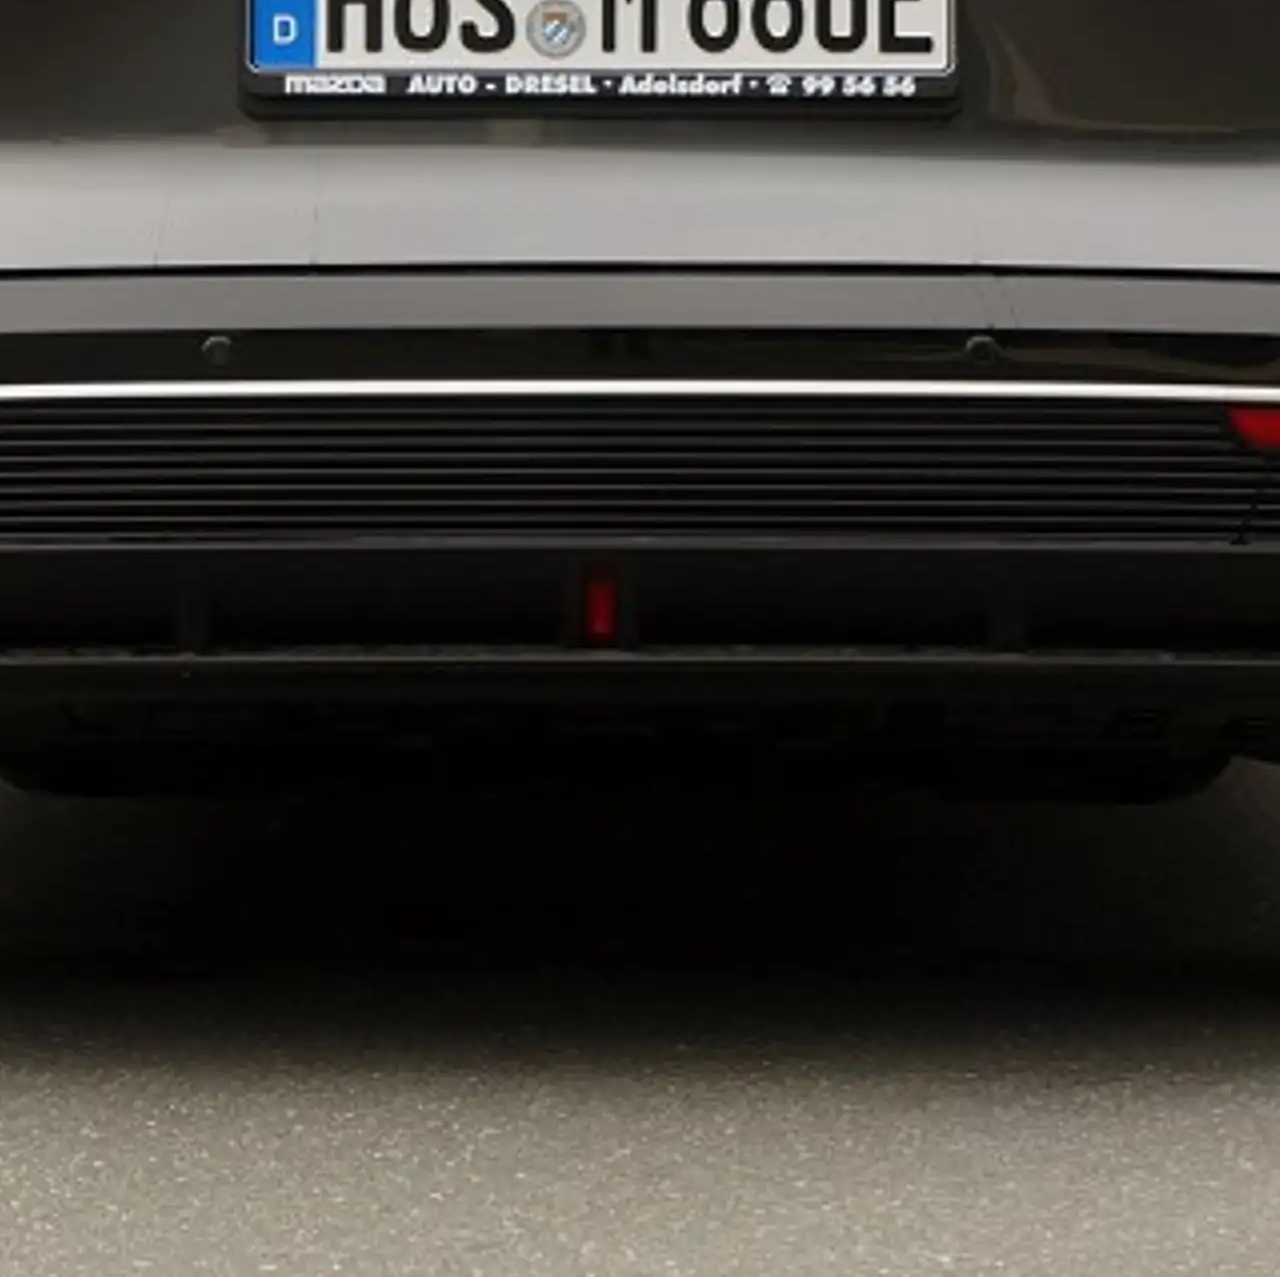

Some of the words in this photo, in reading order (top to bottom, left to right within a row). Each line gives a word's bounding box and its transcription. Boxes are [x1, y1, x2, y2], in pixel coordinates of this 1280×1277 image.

[272, 16, 296, 44] D
[406, 73, 478, 94] AUTO
[504, 73, 597, 94] DRESEL
[618, 73, 742, 95] Adelsdorf
